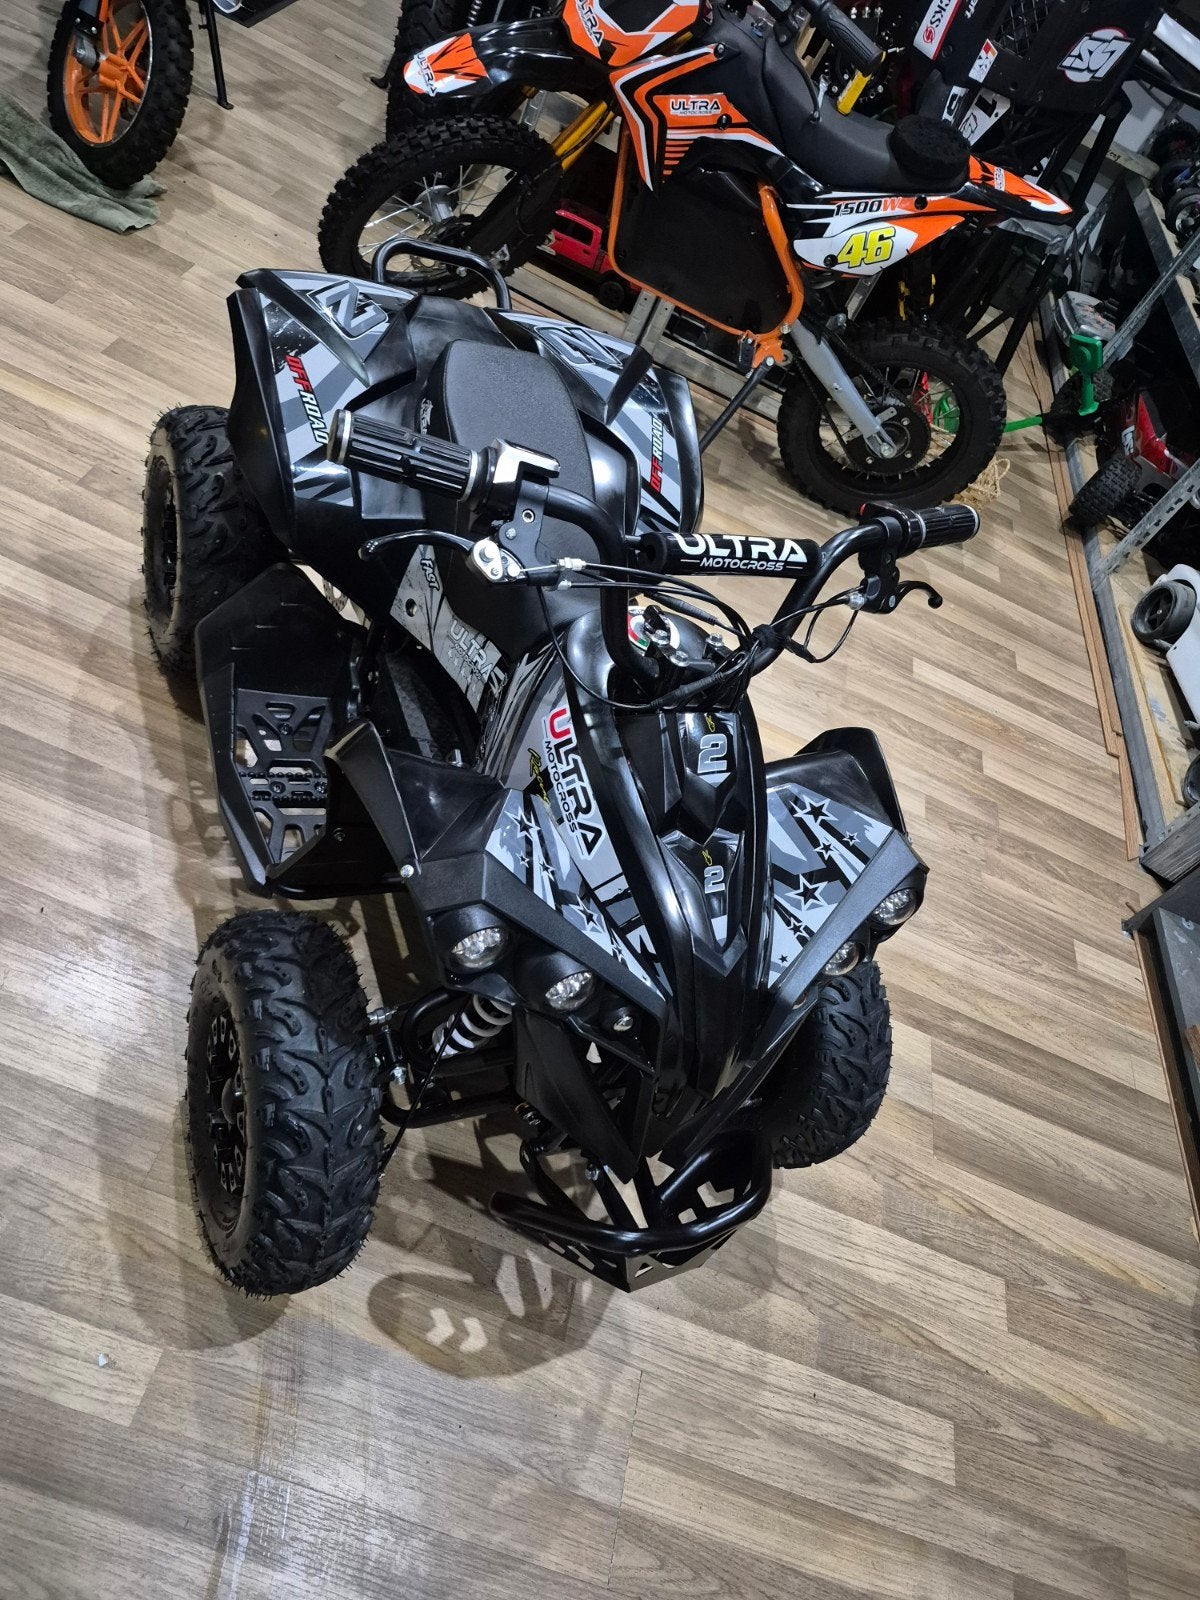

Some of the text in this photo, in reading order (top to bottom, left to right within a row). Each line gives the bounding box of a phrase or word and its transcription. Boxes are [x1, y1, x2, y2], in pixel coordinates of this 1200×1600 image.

[416, 52, 437, 93] ULTRA
[671, 100, 720, 110] ULTRA
[834, 197, 902, 216] 1500W
[837, 226, 896, 268] 46
[672, 533, 808, 563] ULTRA
[700, 557, 785, 571] MOTOCROSS
[450, 619, 494, 684] ULTRA
[697, 733, 728, 774] 2
[544, 740, 578, 833] MOTOCROSS
[549, 707, 604, 856] ULTRA
[704, 865, 726, 894] 2
